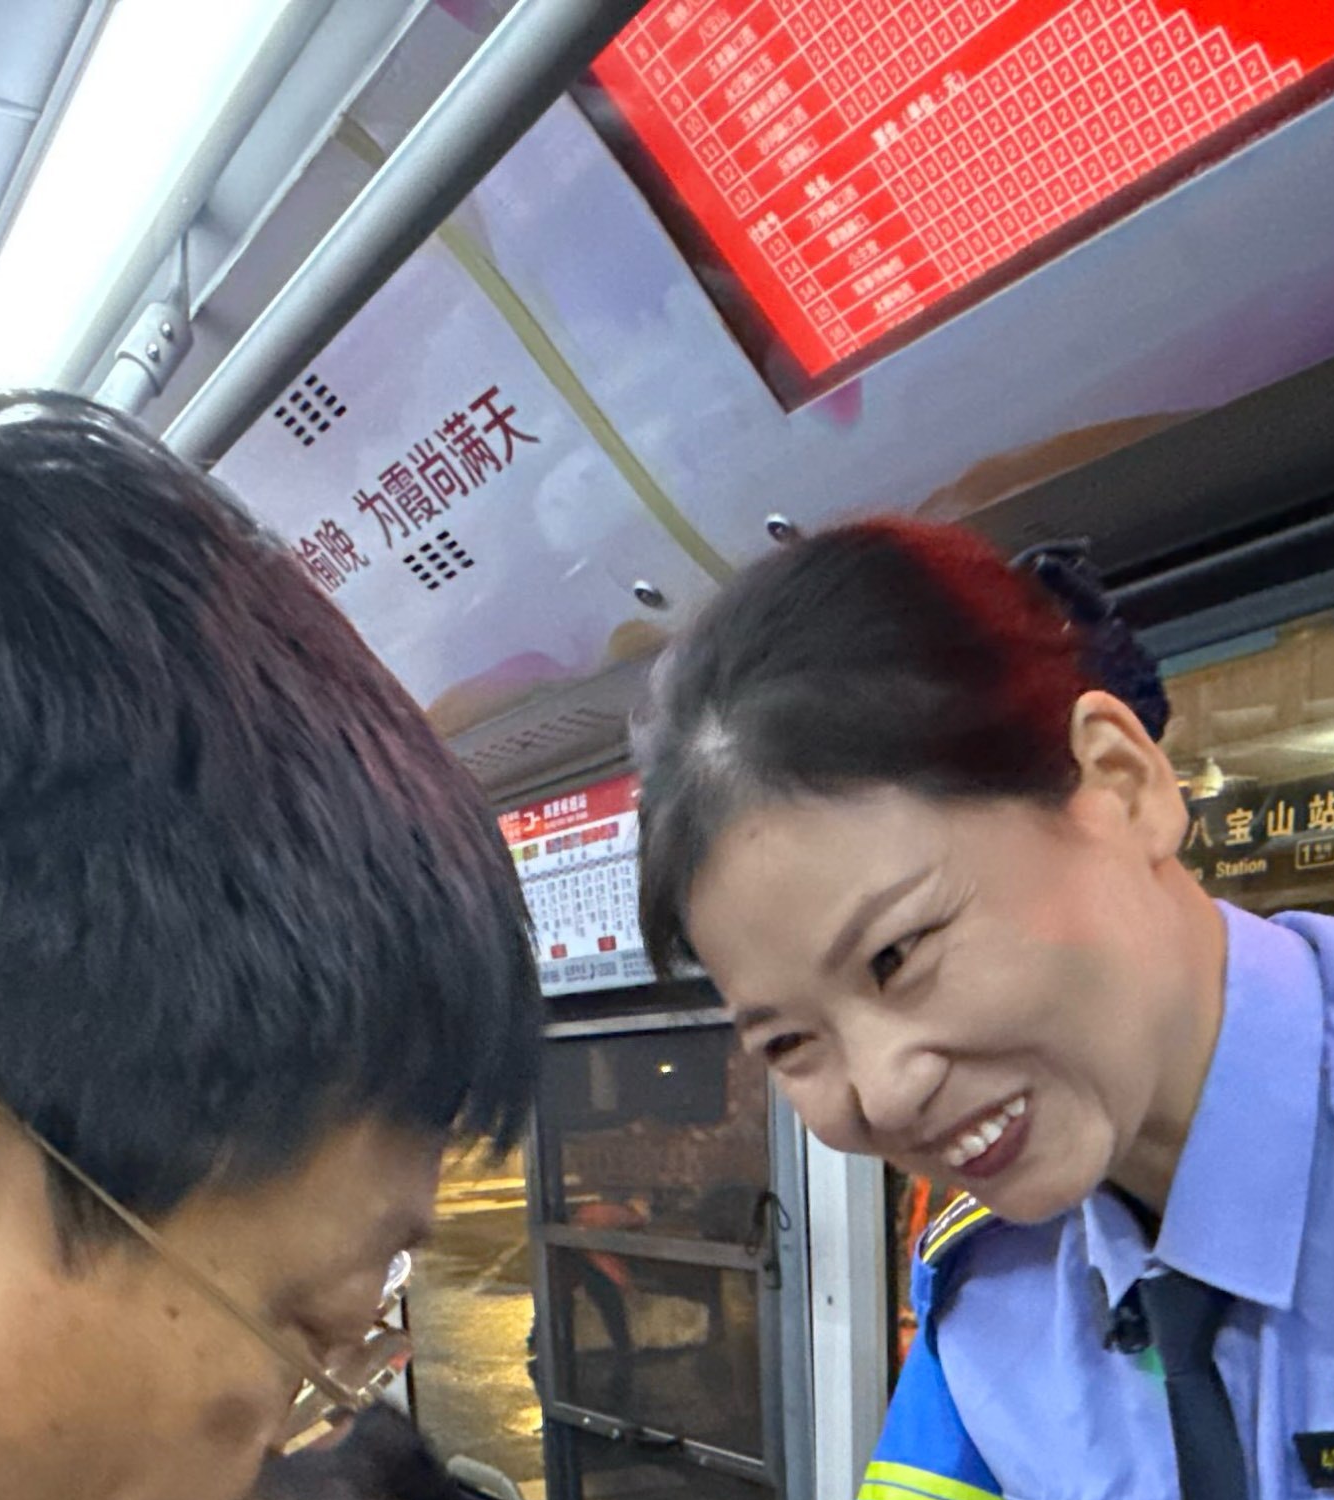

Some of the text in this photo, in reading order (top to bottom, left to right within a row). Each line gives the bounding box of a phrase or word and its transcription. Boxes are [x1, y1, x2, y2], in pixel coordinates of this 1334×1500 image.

[795, 22, 806, 38] 2
[809, 8, 821, 25] 2
[812, 49, 824, 66] 2
[827, 36, 838, 53] 2
[841, 23, 853, 40] 2
[856, 10, 869, 28] 2
[829, 77, 840, 92] 3
[844, 65, 856, 80] 2
[858, 52, 870, 68] 2
[874, 39, 885, 55] 2
[889, 26, 901, 43] 2
[905, 12, 917, 29] 2
[846, 104, 857, 118] 3
[860, 91, 872, 107] 2
[875, 79, 887, 95] 2
[891, 67, 902, 83] 2
[906, 54, 918, 70] 2
[922, 41, 934, 58] 2
[938, 27, 950, 44] 2
[955, 14, 968, 32] 2
[881, 159, 892, 173] 3
[896, 148, 906, 162] 3
[911, 136, 921, 151] 2
[926, 125, 937, 140] 2
[941, 113, 953, 129] 2
[958, 101, 969, 117] 2
[974, 88, 985, 104] 2
[990, 76, 1002, 92] 2
[1008, 62, 1020, 80] 2
[1025, 50, 1038, 67] 2
[1044, 36, 1057, 54] 2
[1062, 22, 1076, 40] 2
[1082, 8, 1094, 26] 2
[896, 184, 907, 197] 3
[912, 173, 922, 187] 3
[926, 162, 937, 177] 3
[941, 151, 953, 166] 2
[957, 139, 969, 155] 2
[973, 128, 985, 144] 2
[990, 117, 1001, 132] 2
[1007, 104, 1019, 120] 2
[1024, 92, 1036, 108] 2
[1042, 79, 1053, 95] 2
[1060, 66, 1072, 82] 2
[1079, 53, 1091, 69] 2
[1098, 39, 1109, 56] 2
[1117, 23, 1130, 42] 2
[1137, 9, 1151, 28] 2
[912, 209, 923, 222] 3
[927, 198, 938, 212] 3
[942, 188, 953, 202] 3
[957, 177, 968, 192] 2
[973, 166, 984, 181] 2
[989, 155, 1000, 170] 2
[1006, 143, 1017, 159] 2
[1023, 131, 1034, 147] 2
[1039, 119, 1052, 136] 2
[1058, 107, 1069, 123] 2
[1076, 94, 1088, 111] 2
[1095, 82, 1106, 98] 2
[1114, 69, 1125, 85] 2
[1134, 55, 1145, 72] 2
[1154, 41, 1165, 58] 2
[1173, 26, 1187, 45] 2
[928, 233, 938, 246] 3
[942, 223, 953, 236] 3
[957, 212, 968, 226] 3
[972, 202, 983, 216] 3
[988, 192, 999, 206] 2
[1004, 181, 1016, 196] 2
[1021, 170, 1032, 185] 2
[1038, 158, 1049, 174] 2
[1056, 146, 1067, 163] 2
[1073, 135, 1084, 151] 2
[1091, 122, 1103, 139] 2
[1110, 110, 1122, 127] 2
[1129, 97, 1141, 114] 2
[1148, 84, 1161, 101] 2
[1168, 71, 1181, 88] 2
[1190, 57, 1201, 74] 2
[1210, 43, 1222, 60] 2
[943, 257, 952, 269] 3
[957, 247, 968, 260] 3
[972, 237, 982, 250] 3
[988, 227, 998, 241] 3
[1003, 216, 1014, 230] 3
[1019, 206, 1030, 221] 2
[1036, 196, 1047, 210] 2
[1053, 184, 1064, 200] 2
[1070, 173, 1082, 189] 2
[1088, 162, 1099, 178] 2
[1106, 150, 1117, 166] 2
[1124, 138, 1137, 154] 2
[1144, 126, 1156, 142] 2
[1163, 113, 1176, 130] 2
[1183, 101, 1196, 117] 2
[1205, 87, 1216, 104] 2
[1225, 74, 1238, 91] 2
[1247, 60, 1259, 77] 2
[352, 385, 541, 549] 为霞尚满天
[1216, 857, 1267, 879] Station
